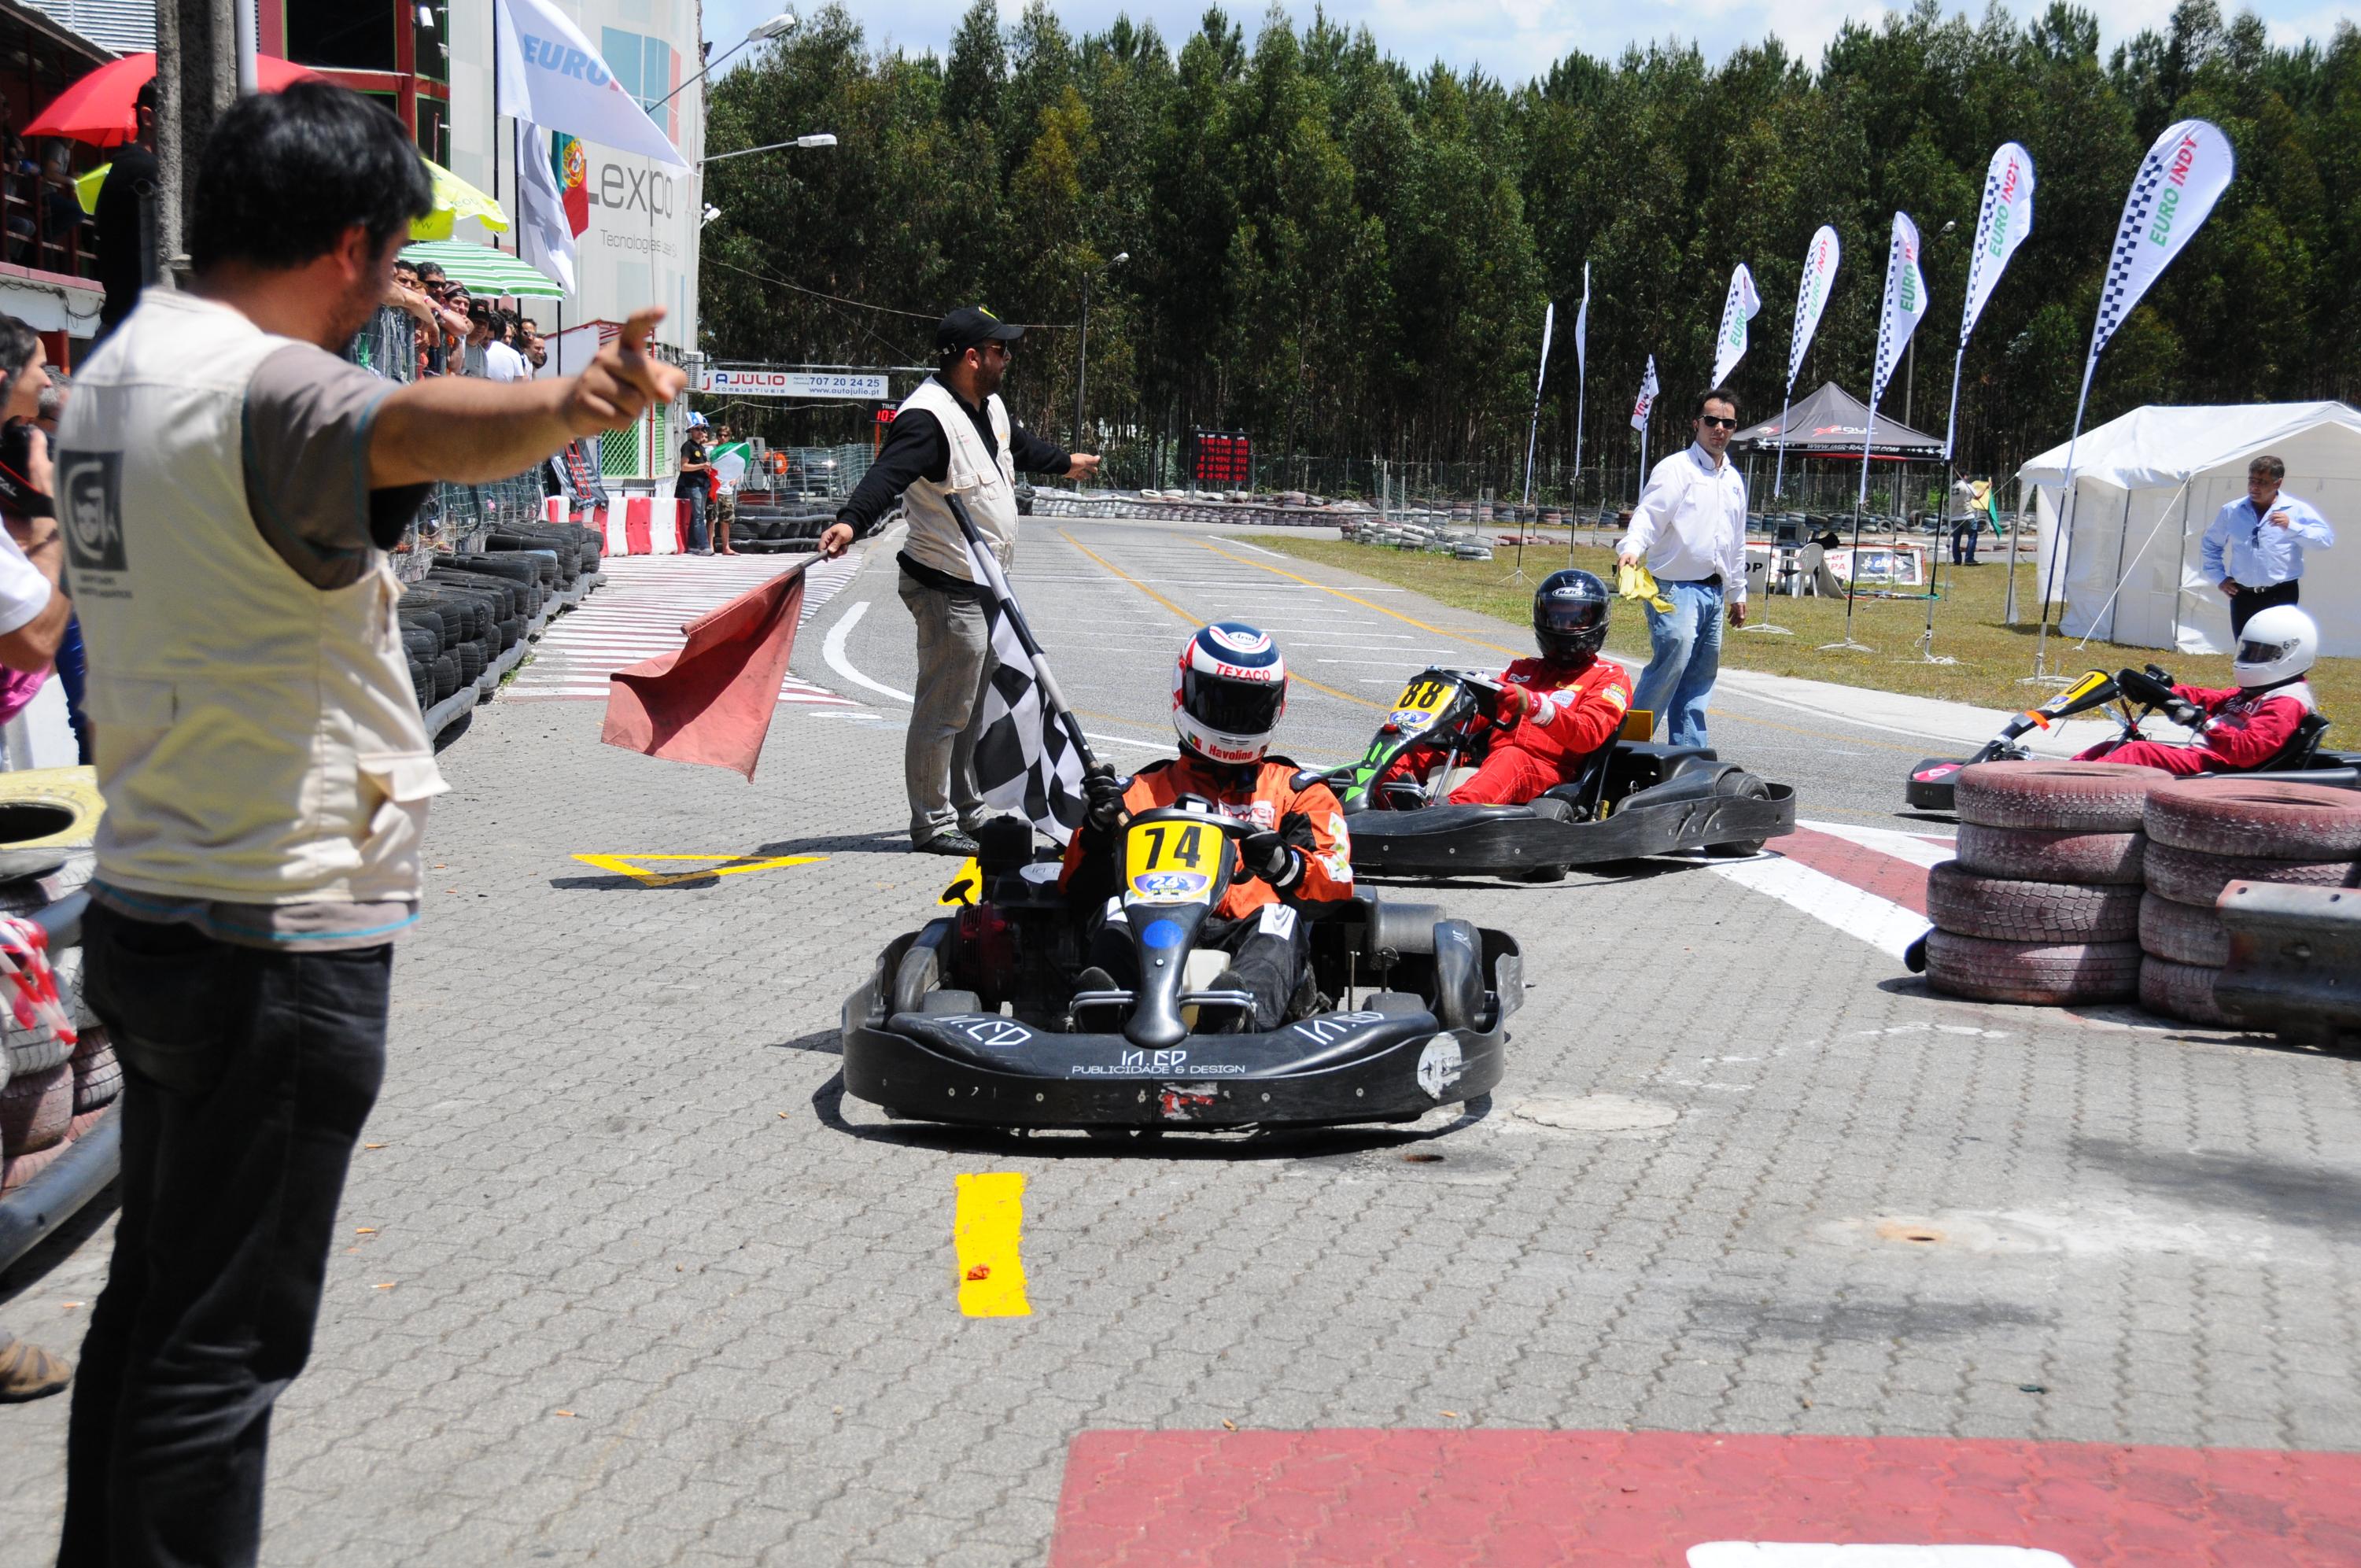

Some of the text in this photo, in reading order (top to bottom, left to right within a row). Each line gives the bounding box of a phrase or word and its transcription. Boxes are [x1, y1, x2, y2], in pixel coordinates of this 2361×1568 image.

[587, 163, 673, 227] expo
[1989, 157, 2020, 257] EURO INDY
[2149, 134, 2197, 247] EURO INDY
[1809, 238, 1828, 319] EURO INDY
[1900, 264, 1916, 312] EURO
[1729, 308, 1747, 348] EURO
[809, 387, 880, 396] www.autojulio.pt
[810, 377, 829, 386] 707
[833, 378, 846, 386] 20
[1216, 663, 1271, 682] TEXACO
[1399, 681, 1445, 708] 88
[1208, 743, 1253, 761] Havoline
[1145, 825, 1201, 871] 74
[1072, 1064, 1245, 1075] PUBLICIDADE & DESIGN
